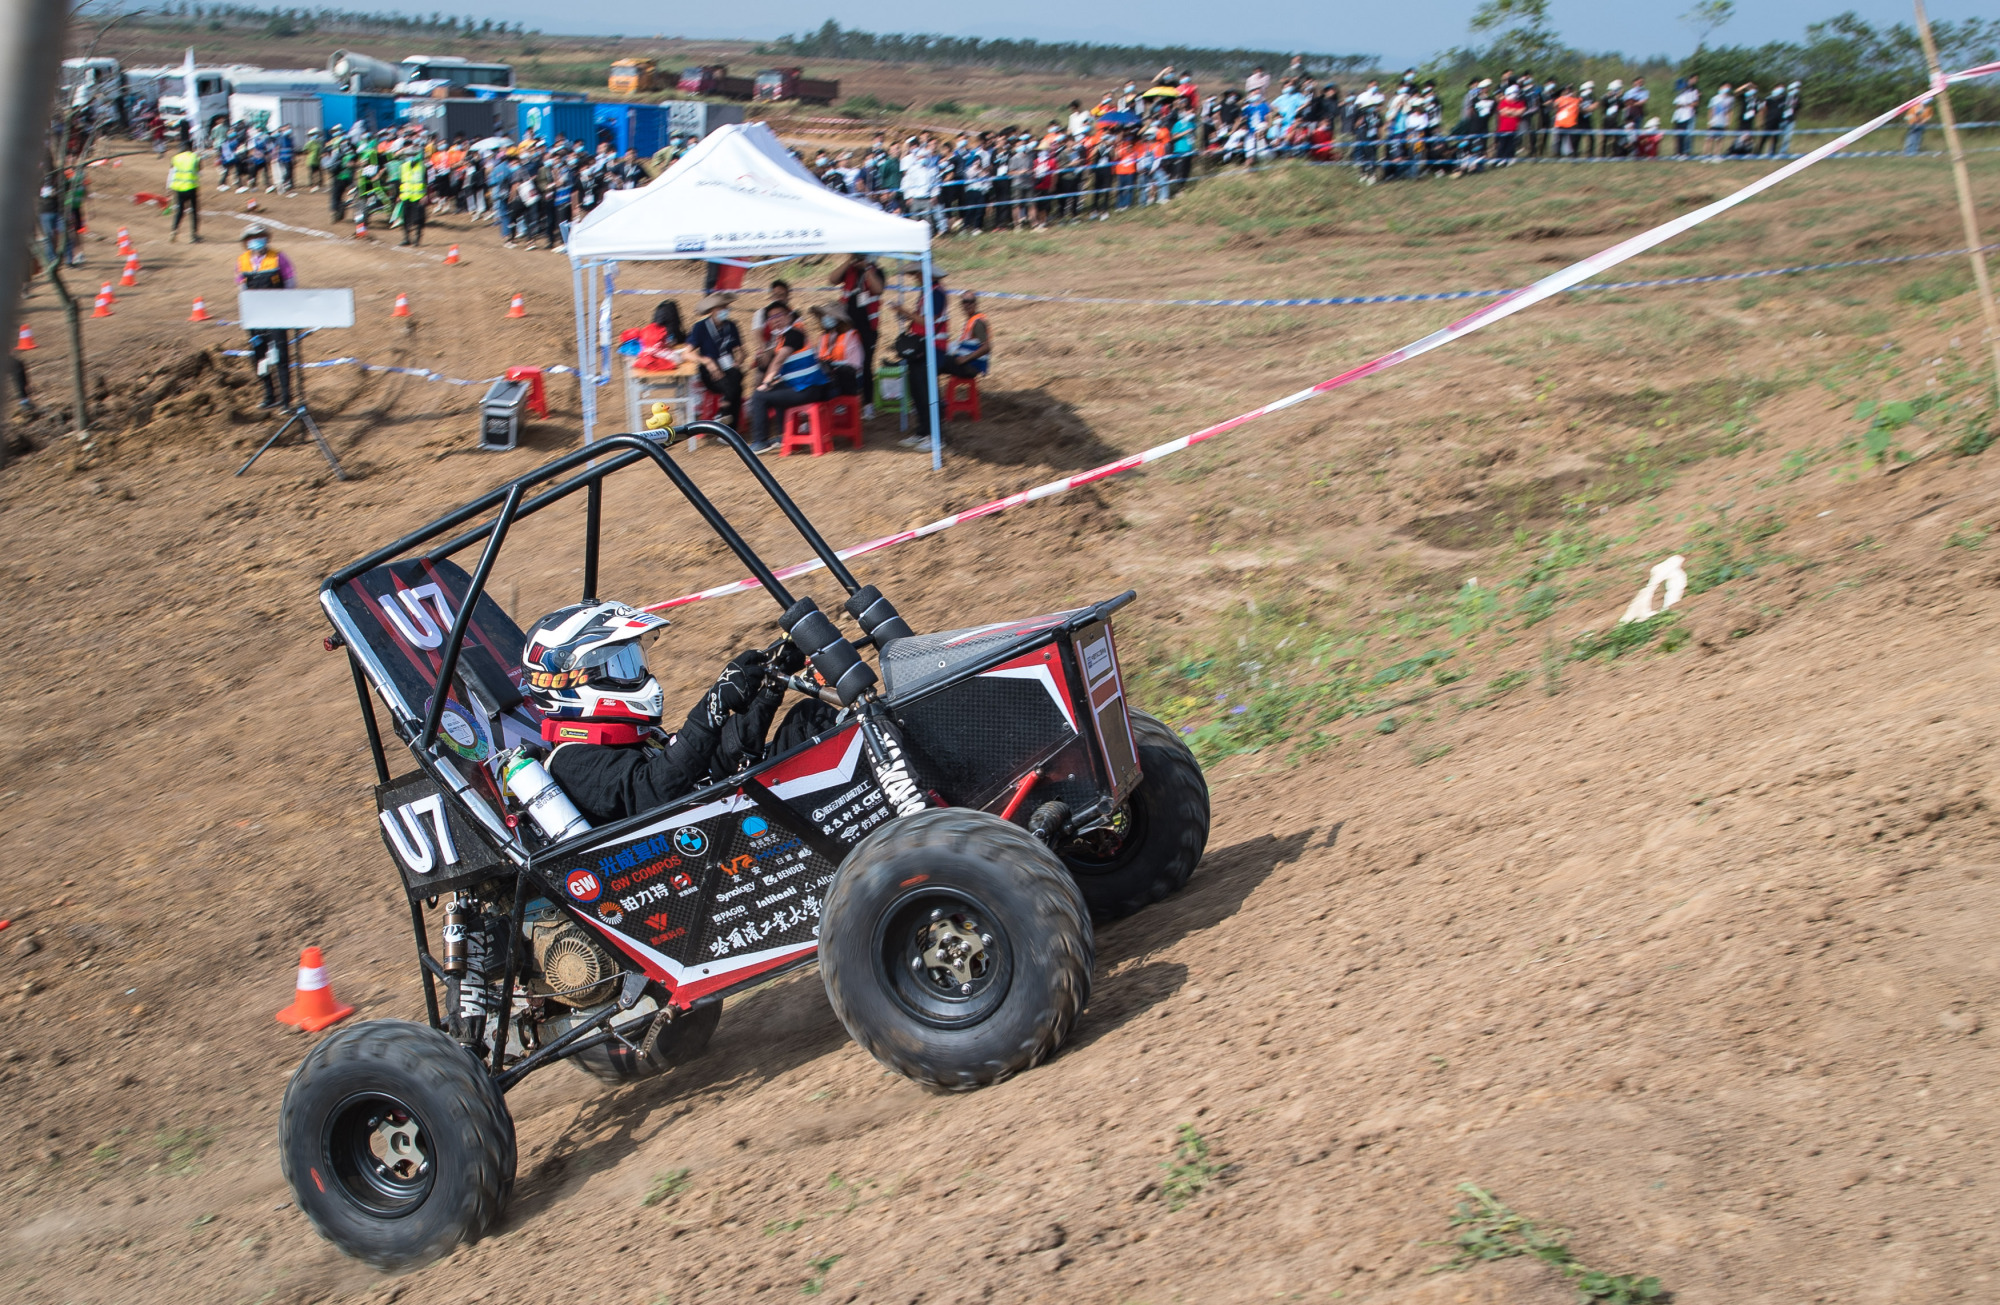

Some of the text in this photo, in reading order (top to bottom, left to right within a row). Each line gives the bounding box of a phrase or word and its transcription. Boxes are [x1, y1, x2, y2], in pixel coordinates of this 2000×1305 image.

[530, 667, 588, 689] 100%
[380, 793, 459, 874] U7
[598, 834, 670, 877] 光威复材
[755, 837, 802, 861] HIOKI
[610, 855, 682, 891] GW COMPOS
[776, 863, 806, 880] BENDER
[570, 874, 597, 896] GW
[716, 881, 755, 902] Synology
[620, 883, 670, 912] 铂力特
[720, 905, 746, 919] PAGID
[460, 931, 487, 1018] YAMAHA
